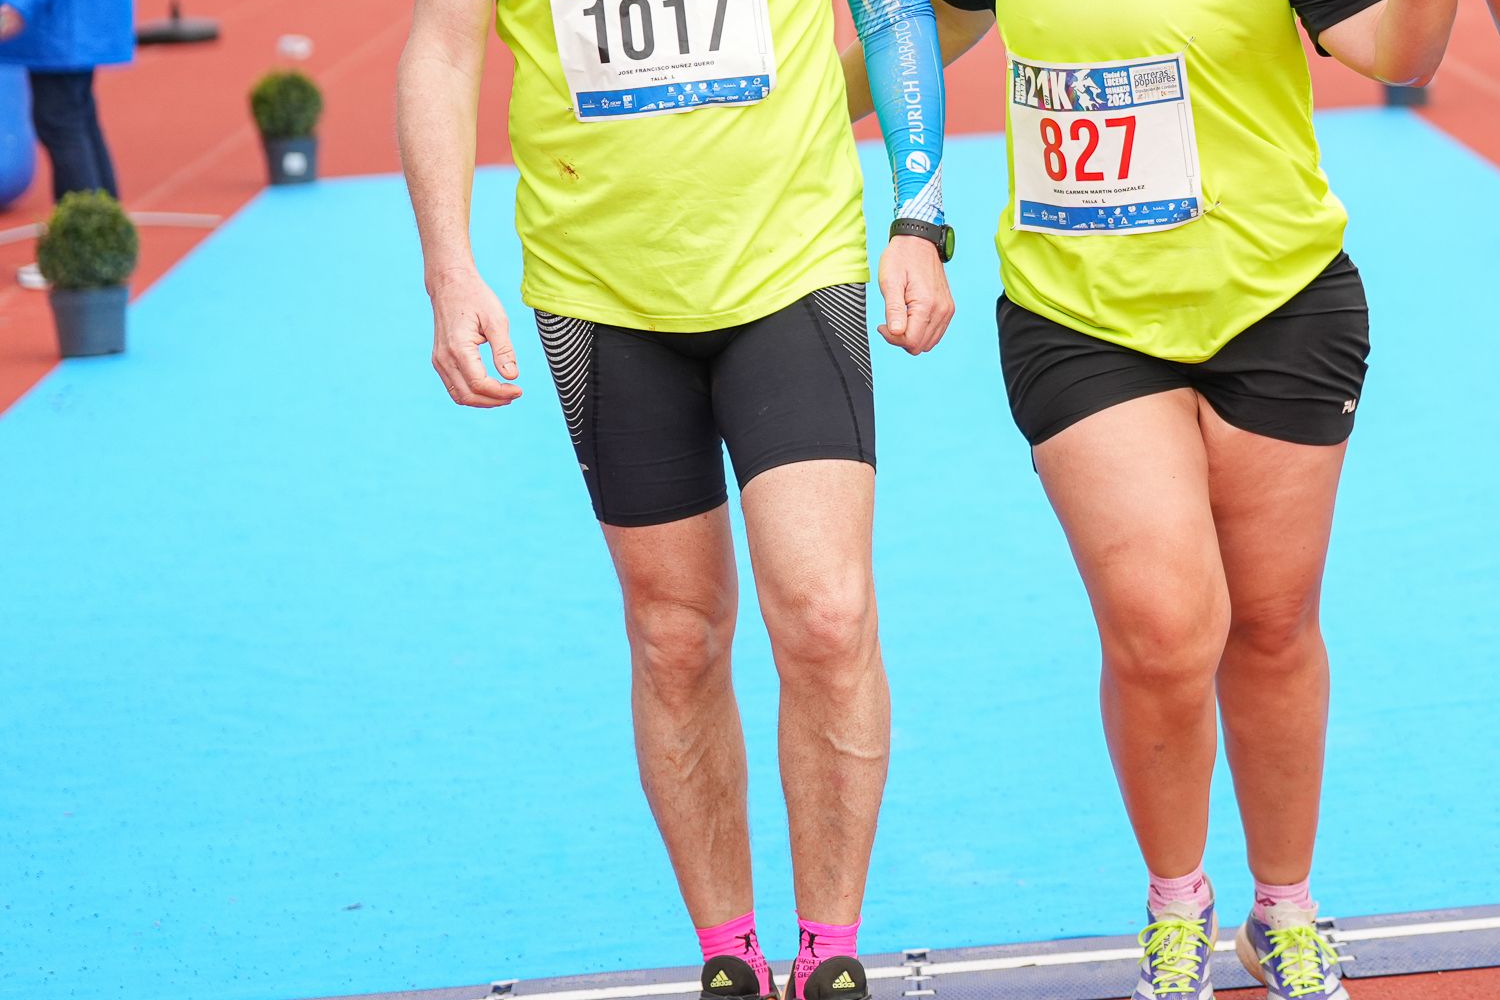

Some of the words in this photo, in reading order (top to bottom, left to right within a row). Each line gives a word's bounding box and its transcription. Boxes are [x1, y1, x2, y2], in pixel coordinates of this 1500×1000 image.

[635, 65, 670, 73] FRANCISCO
[1134, 70, 1169, 80] carreras
[1134, 74, 1176, 88] populares
[1025, 66, 1073, 110] 21K
[1107, 92, 1132, 107] 2026
[903, 80, 925, 145] ZURICH
[1039, 115, 1137, 182] 827
[1114, 184, 1145, 194] GONZALEZ
[710, 979, 733, 988] adidas
[832, 981, 856, 989] adidas
